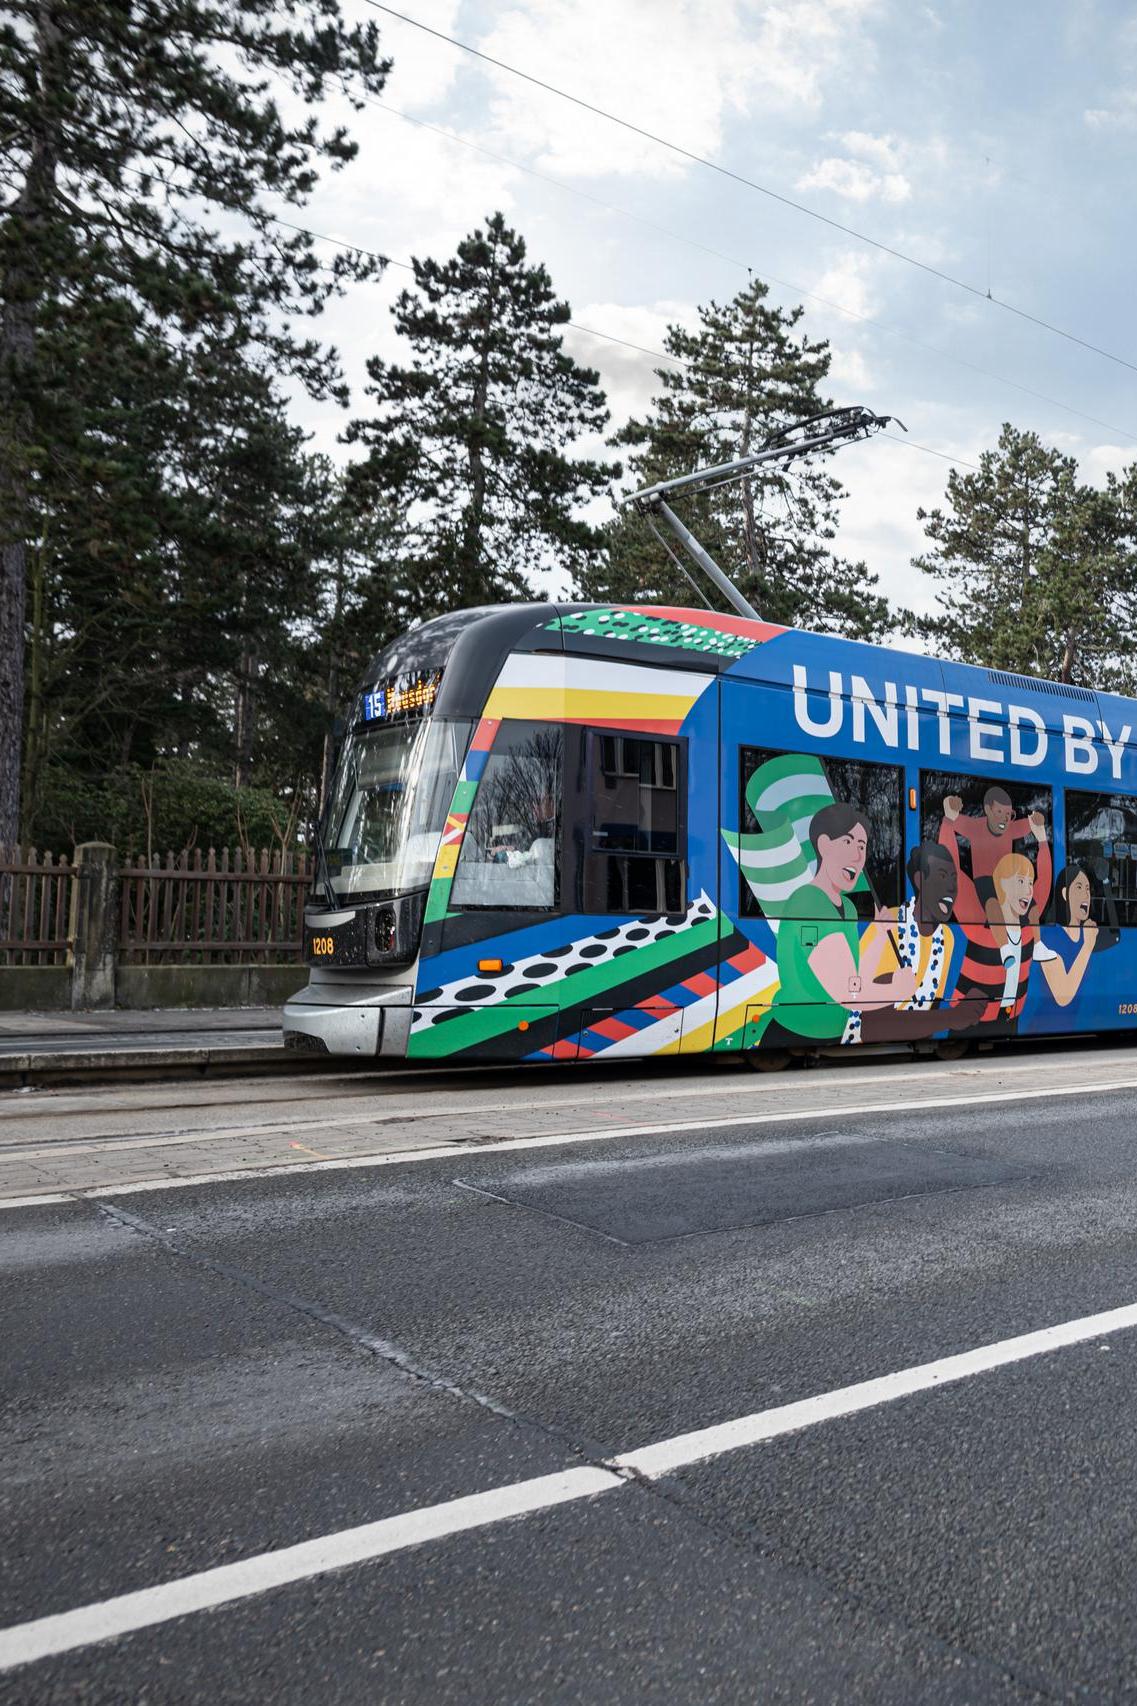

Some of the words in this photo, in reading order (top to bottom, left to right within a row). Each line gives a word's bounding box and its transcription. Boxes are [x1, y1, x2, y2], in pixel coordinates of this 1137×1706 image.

[370, 692, 382, 718] 15
[793, 664, 1048, 767] UNITED
[1062, 714, 1132, 779] BY
[312, 937, 334, 955] 1208
